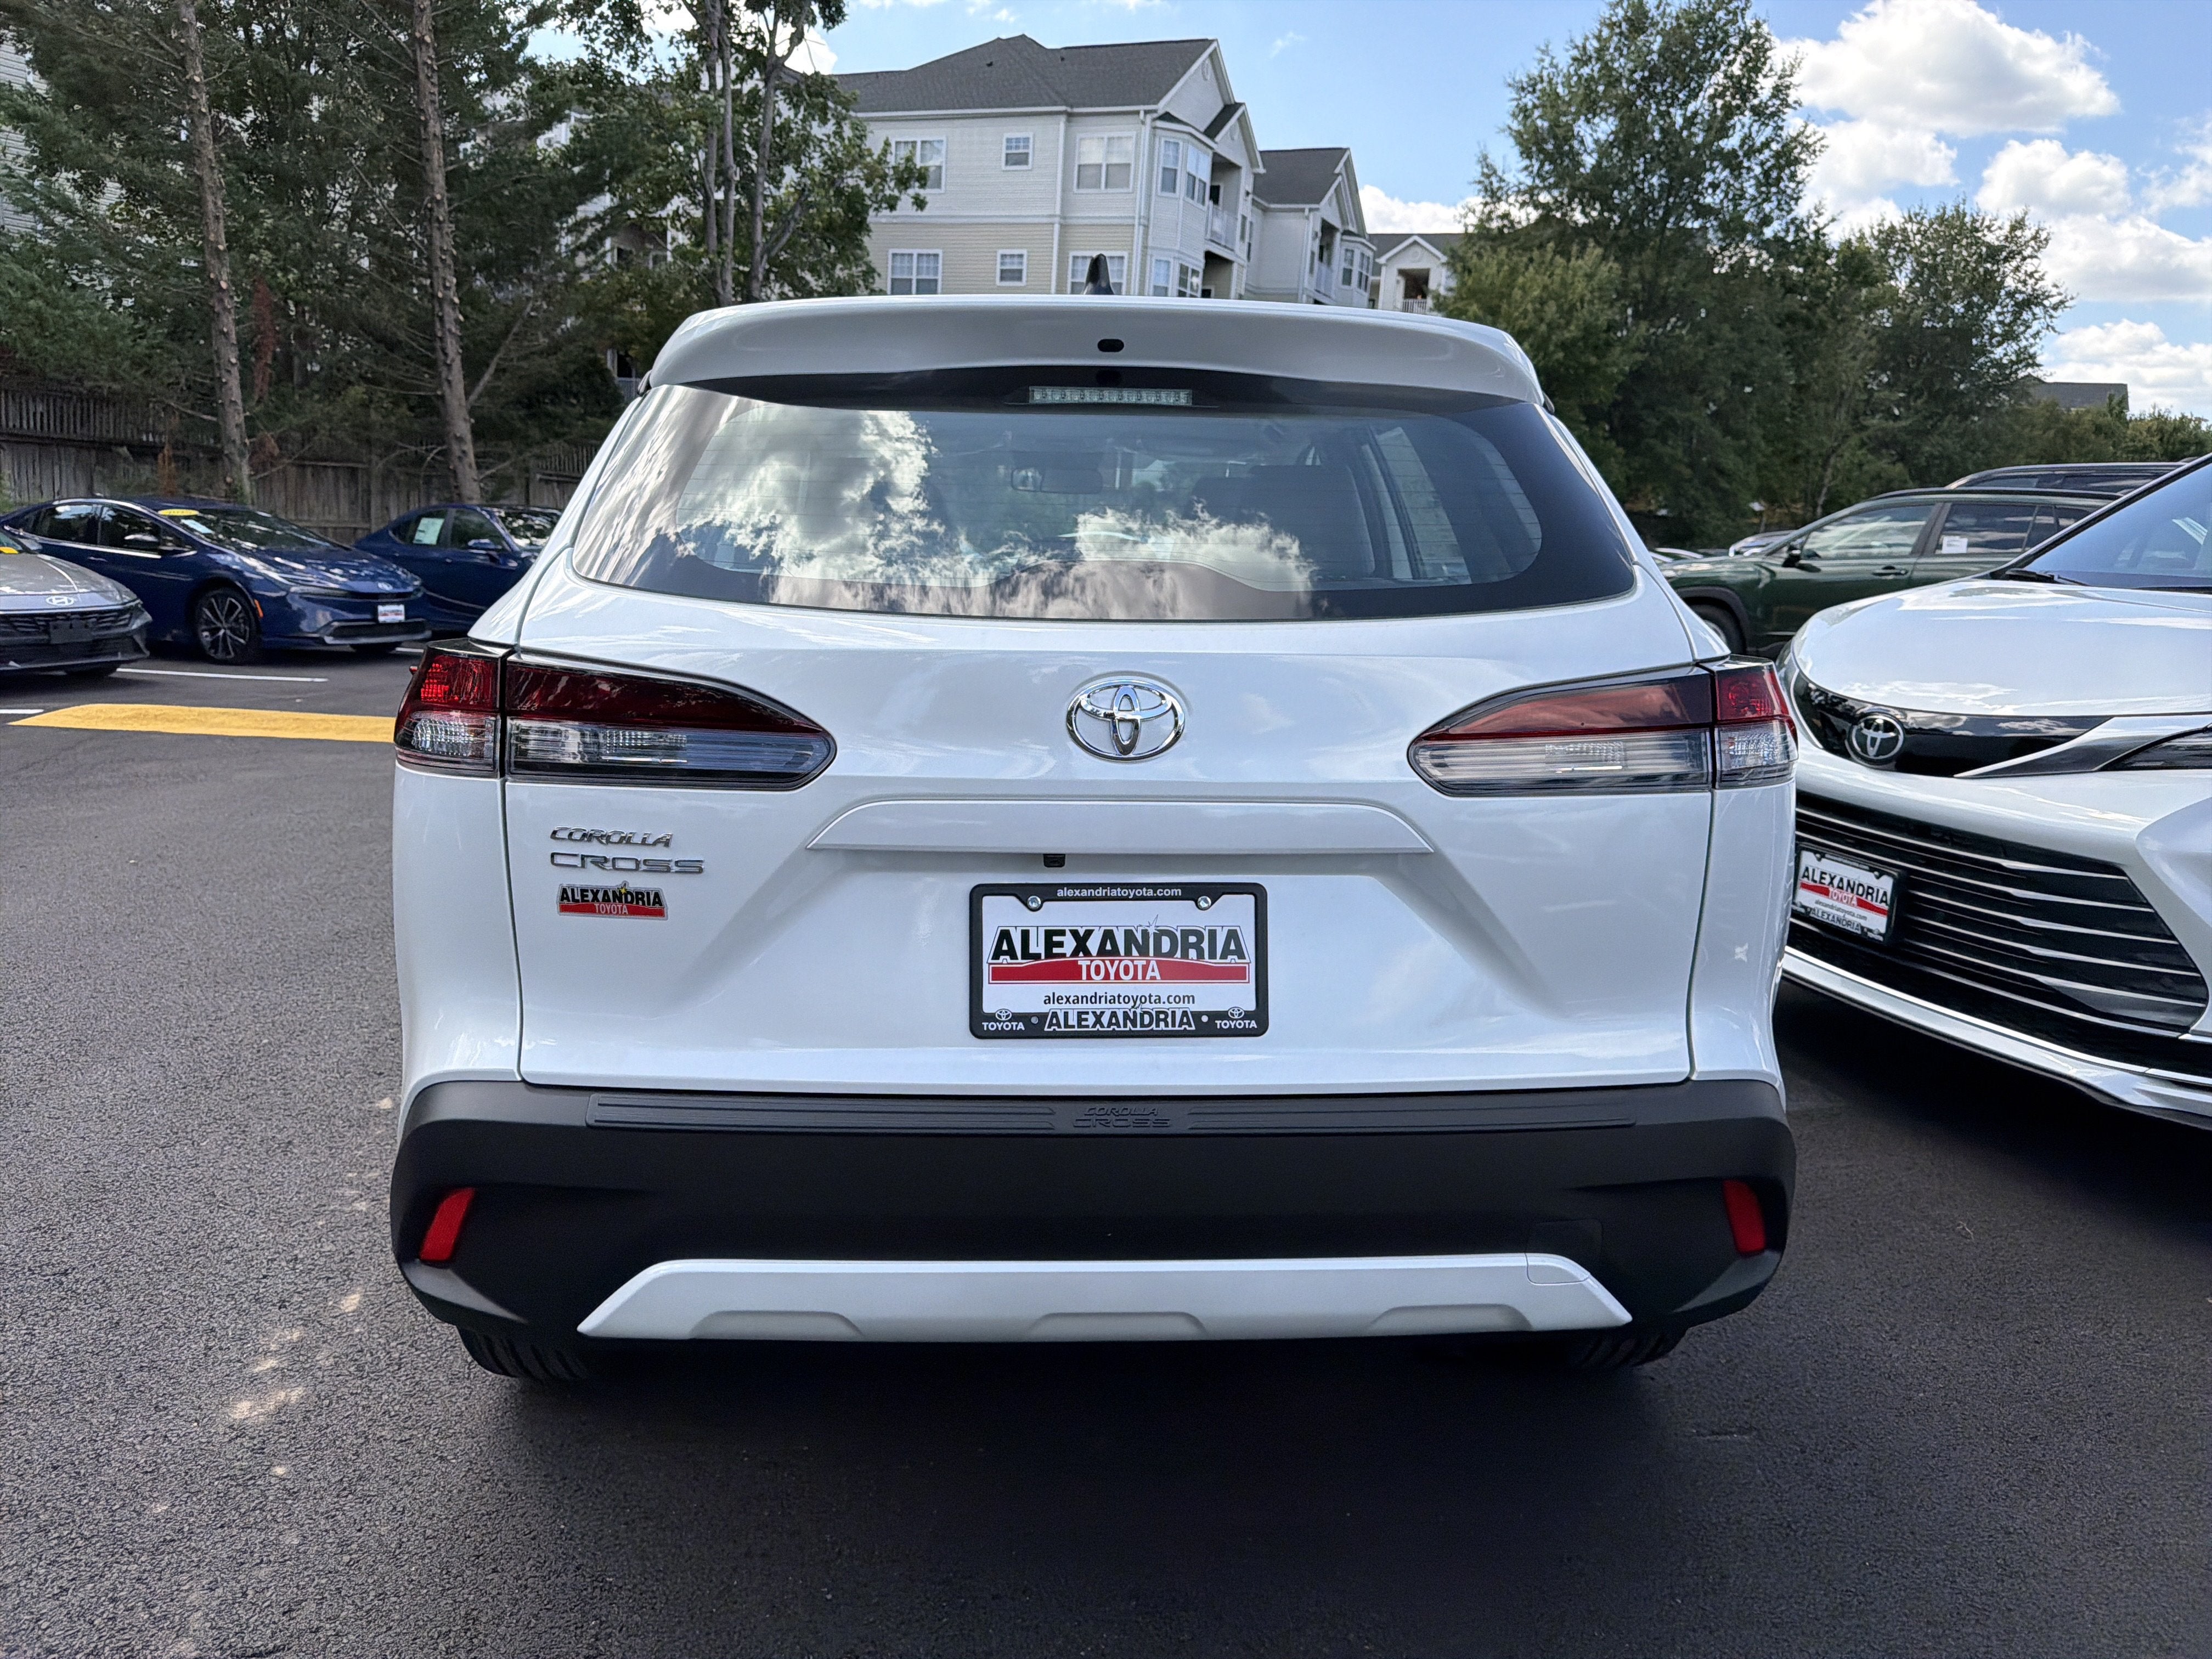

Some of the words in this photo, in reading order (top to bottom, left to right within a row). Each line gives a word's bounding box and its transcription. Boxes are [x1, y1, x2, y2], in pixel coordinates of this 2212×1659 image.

[550, 826, 673, 847] COROLLA
[550, 852, 704, 874] CROSS
[1057, 887, 1182, 899] alexandriatoyota.com
[1802, 866, 1889, 906] ALEXANDRIA
[560, 887, 664, 907] ALEXANDRIA
[1829, 887, 1858, 906] TOYOTA
[594, 903, 629, 915] TOYOTA
[989, 927, 1250, 962] ALEXANDRIA
[1078, 960, 1161, 980] TOYOTA
[1043, 992, 1195, 1007] alexandriatoyota.com
[982, 1022, 1025, 1031] TOYOTA
[1045, 1008, 1195, 1030] ALEXANDRIA
[1215, 1020, 1257, 1029] TOYOTA
